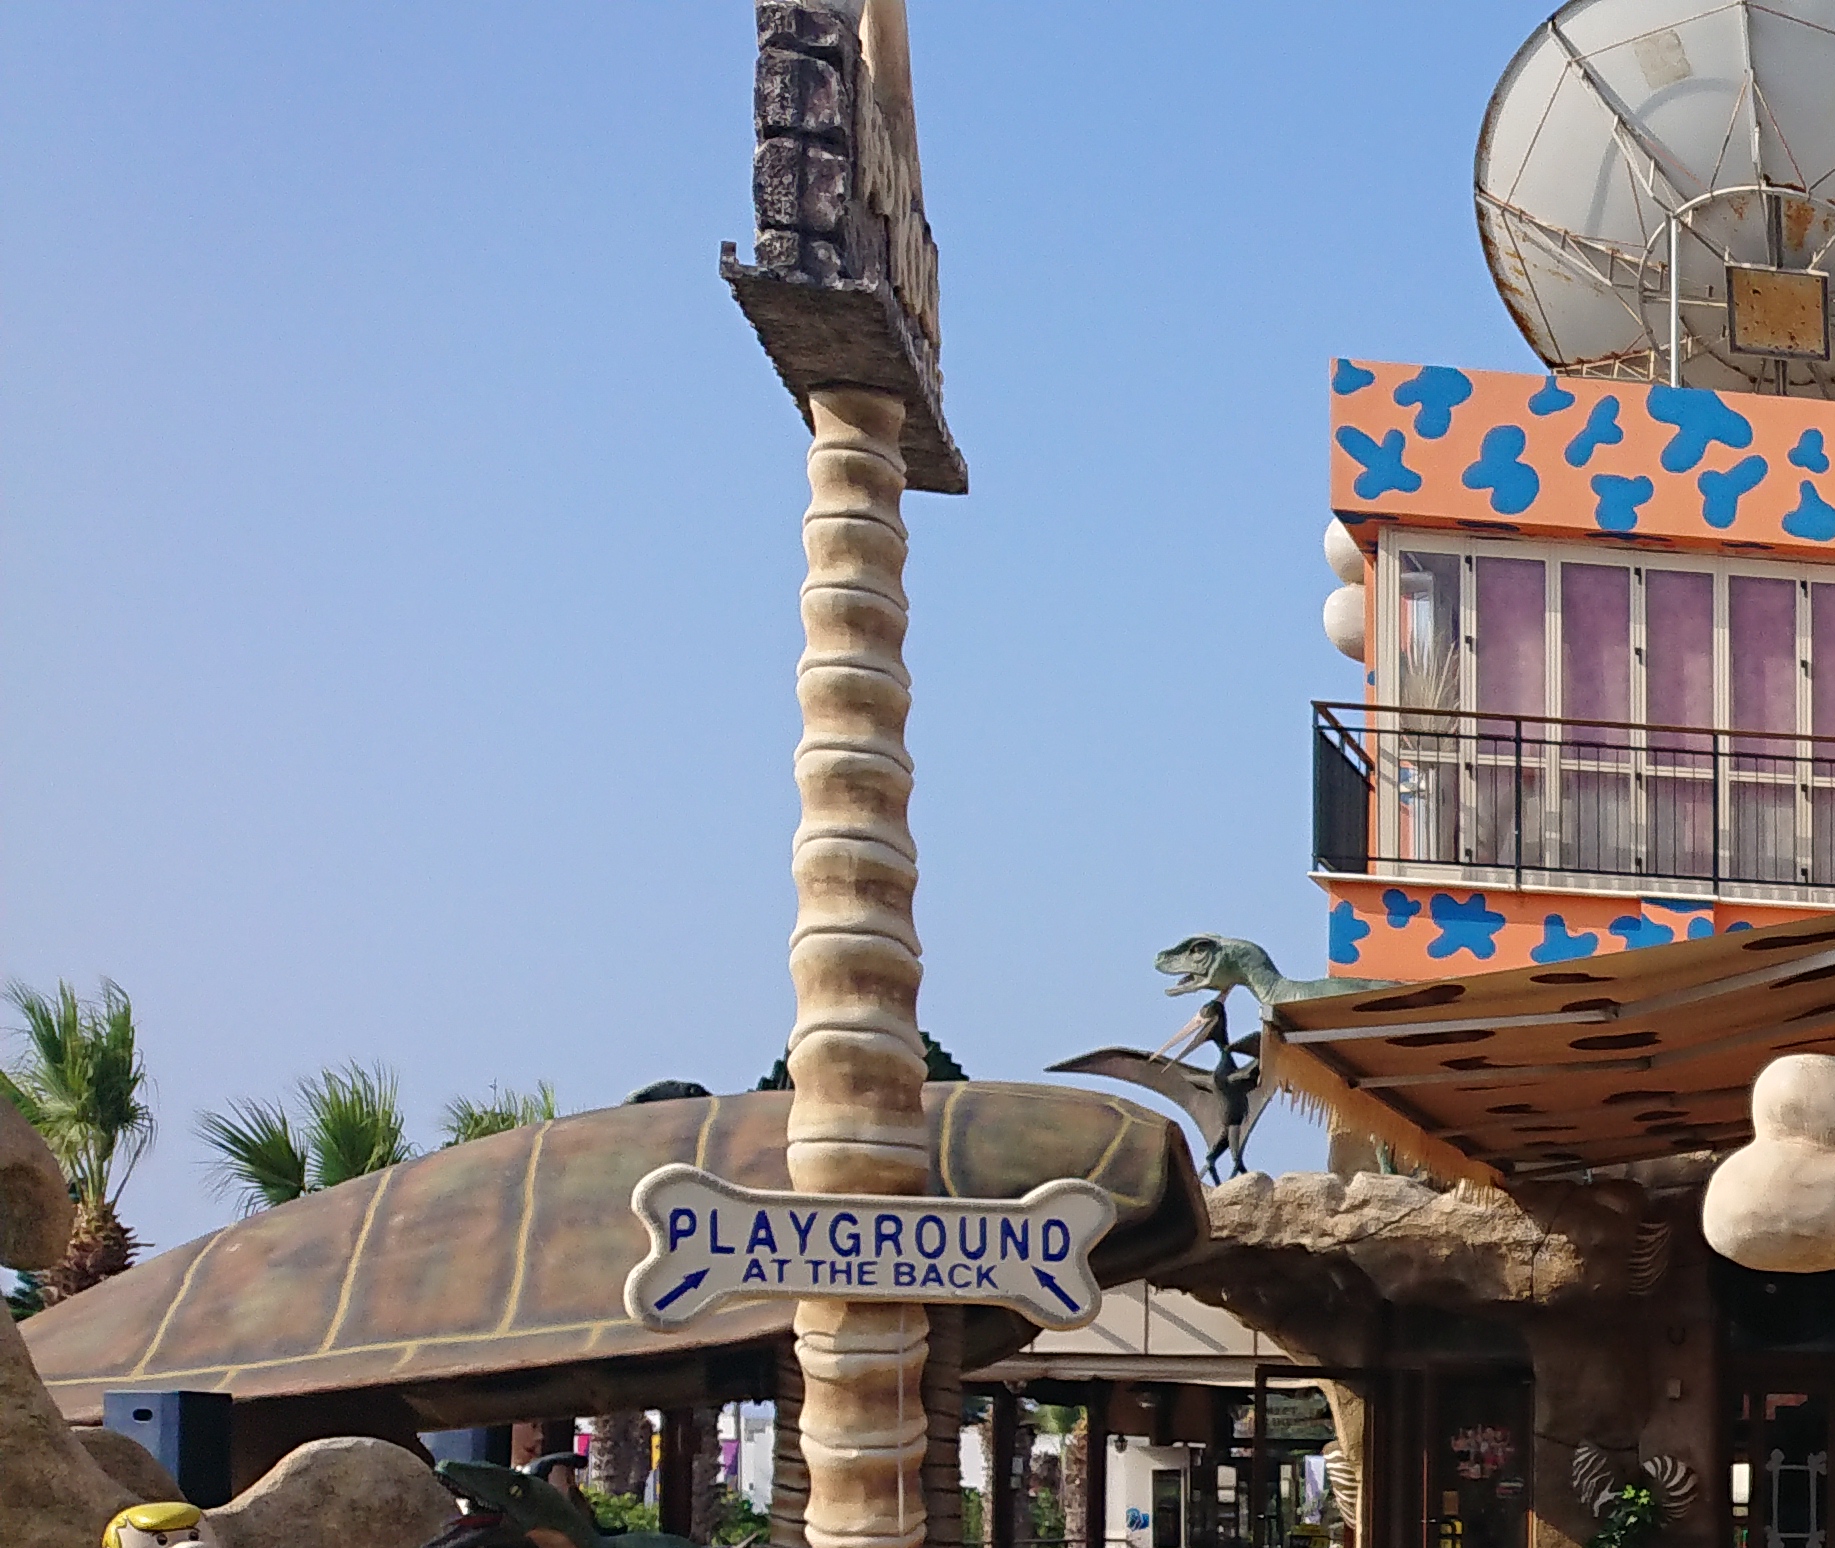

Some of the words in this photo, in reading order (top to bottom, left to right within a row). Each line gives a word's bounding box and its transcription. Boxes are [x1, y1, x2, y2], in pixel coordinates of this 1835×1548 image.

[668, 1207, 1071, 1262] PLAYGROUND
[742, 1257, 792, 1284] AT
[806, 1258, 878, 1287] THE
[893, 1260, 998, 1290] BACK
